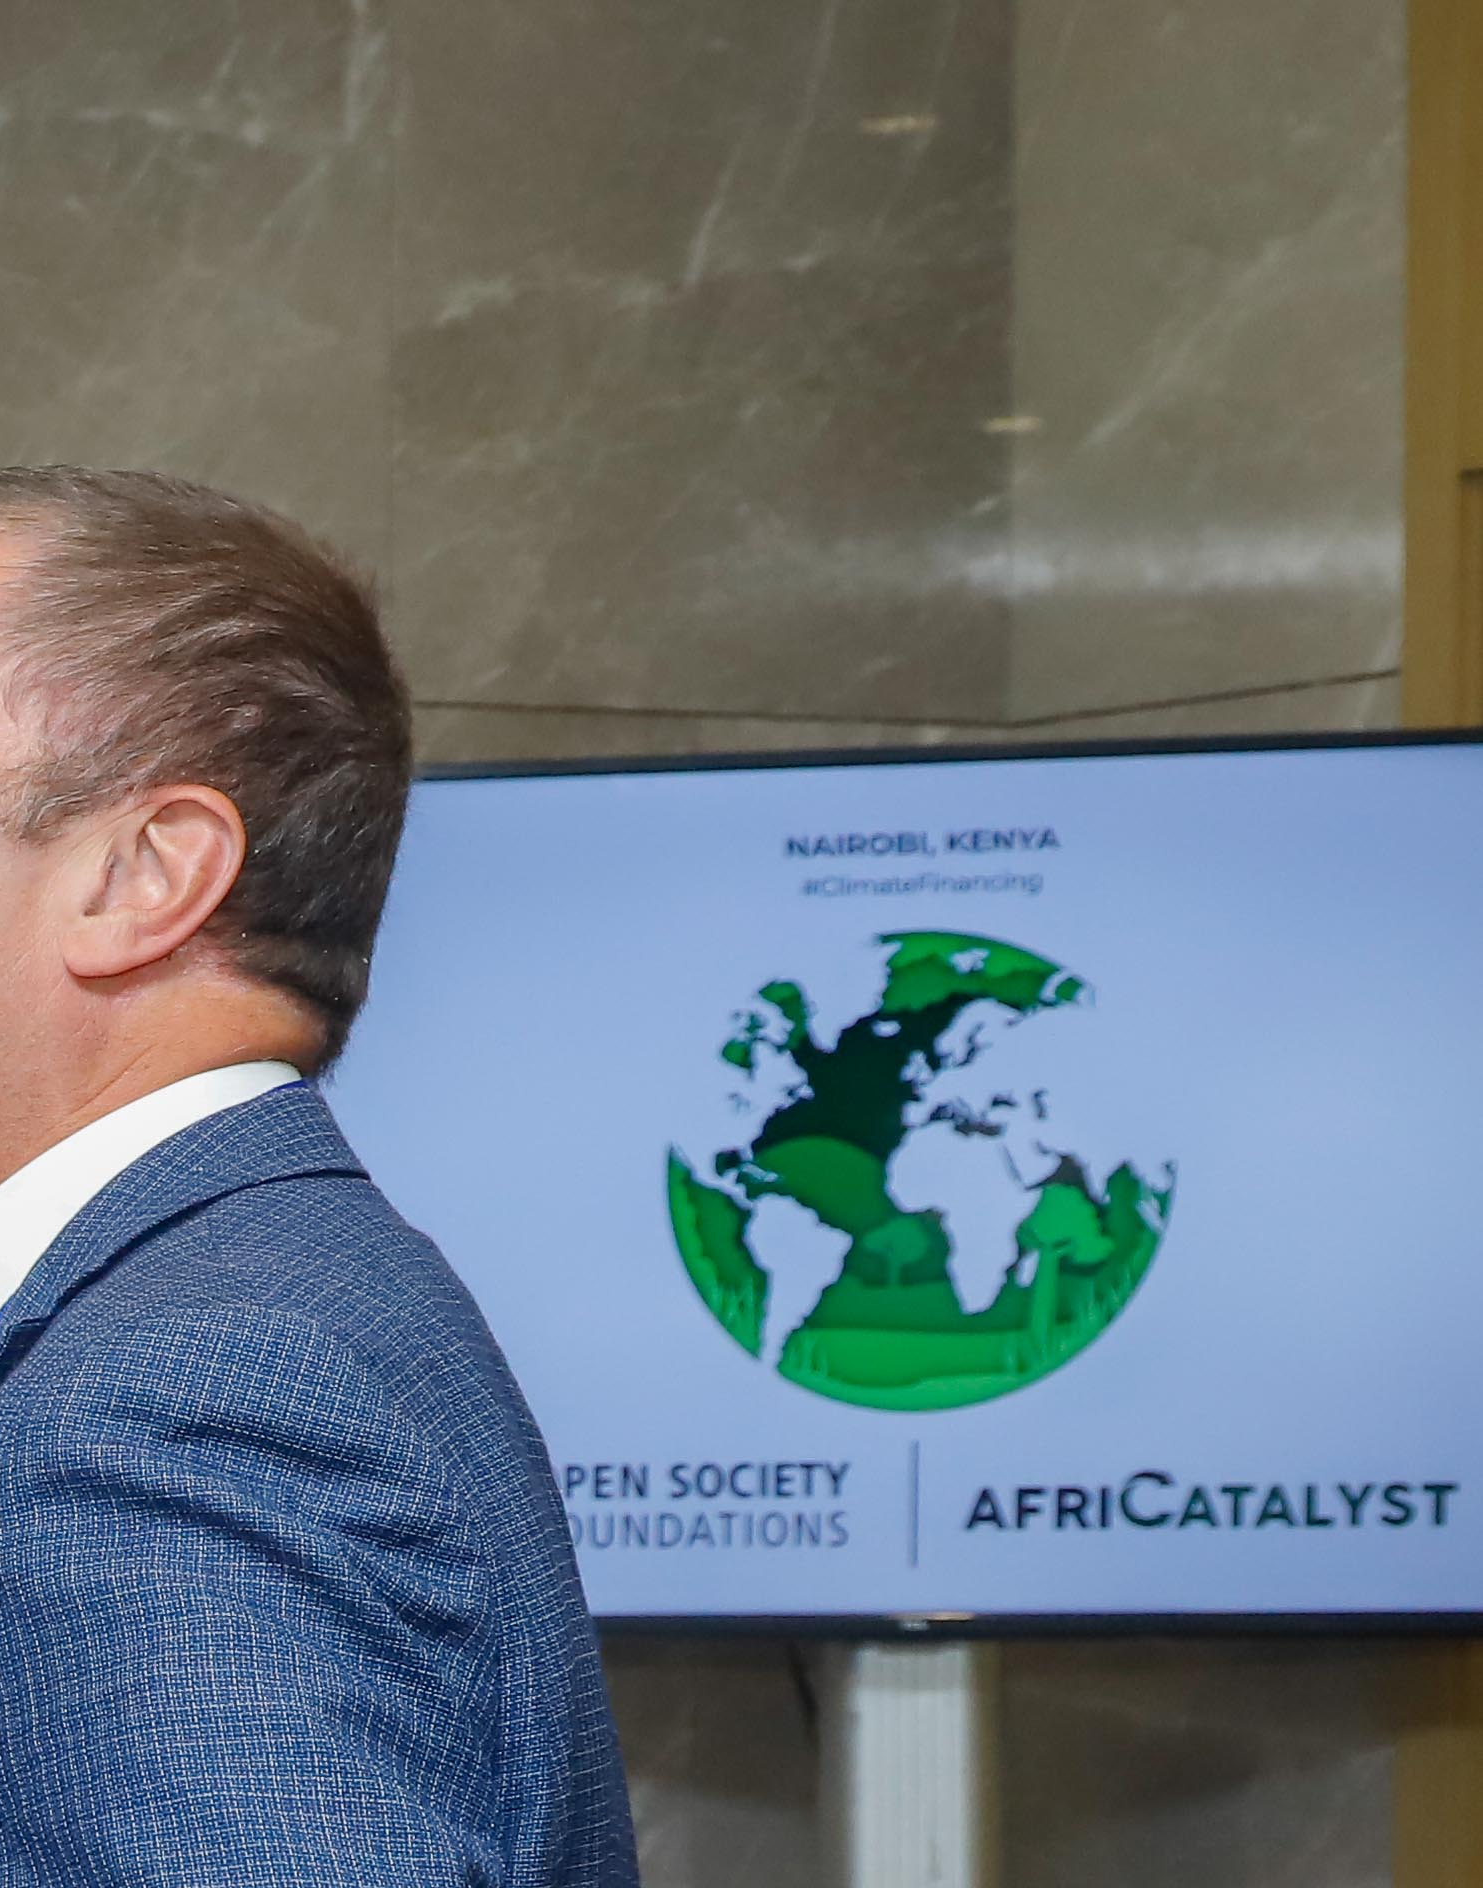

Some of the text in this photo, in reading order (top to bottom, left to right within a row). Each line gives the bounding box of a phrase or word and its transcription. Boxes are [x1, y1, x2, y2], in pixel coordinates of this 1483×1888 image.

[946, 826, 1062, 851] KENYA
[564, 1462, 850, 1499] PEN SOCIETY
